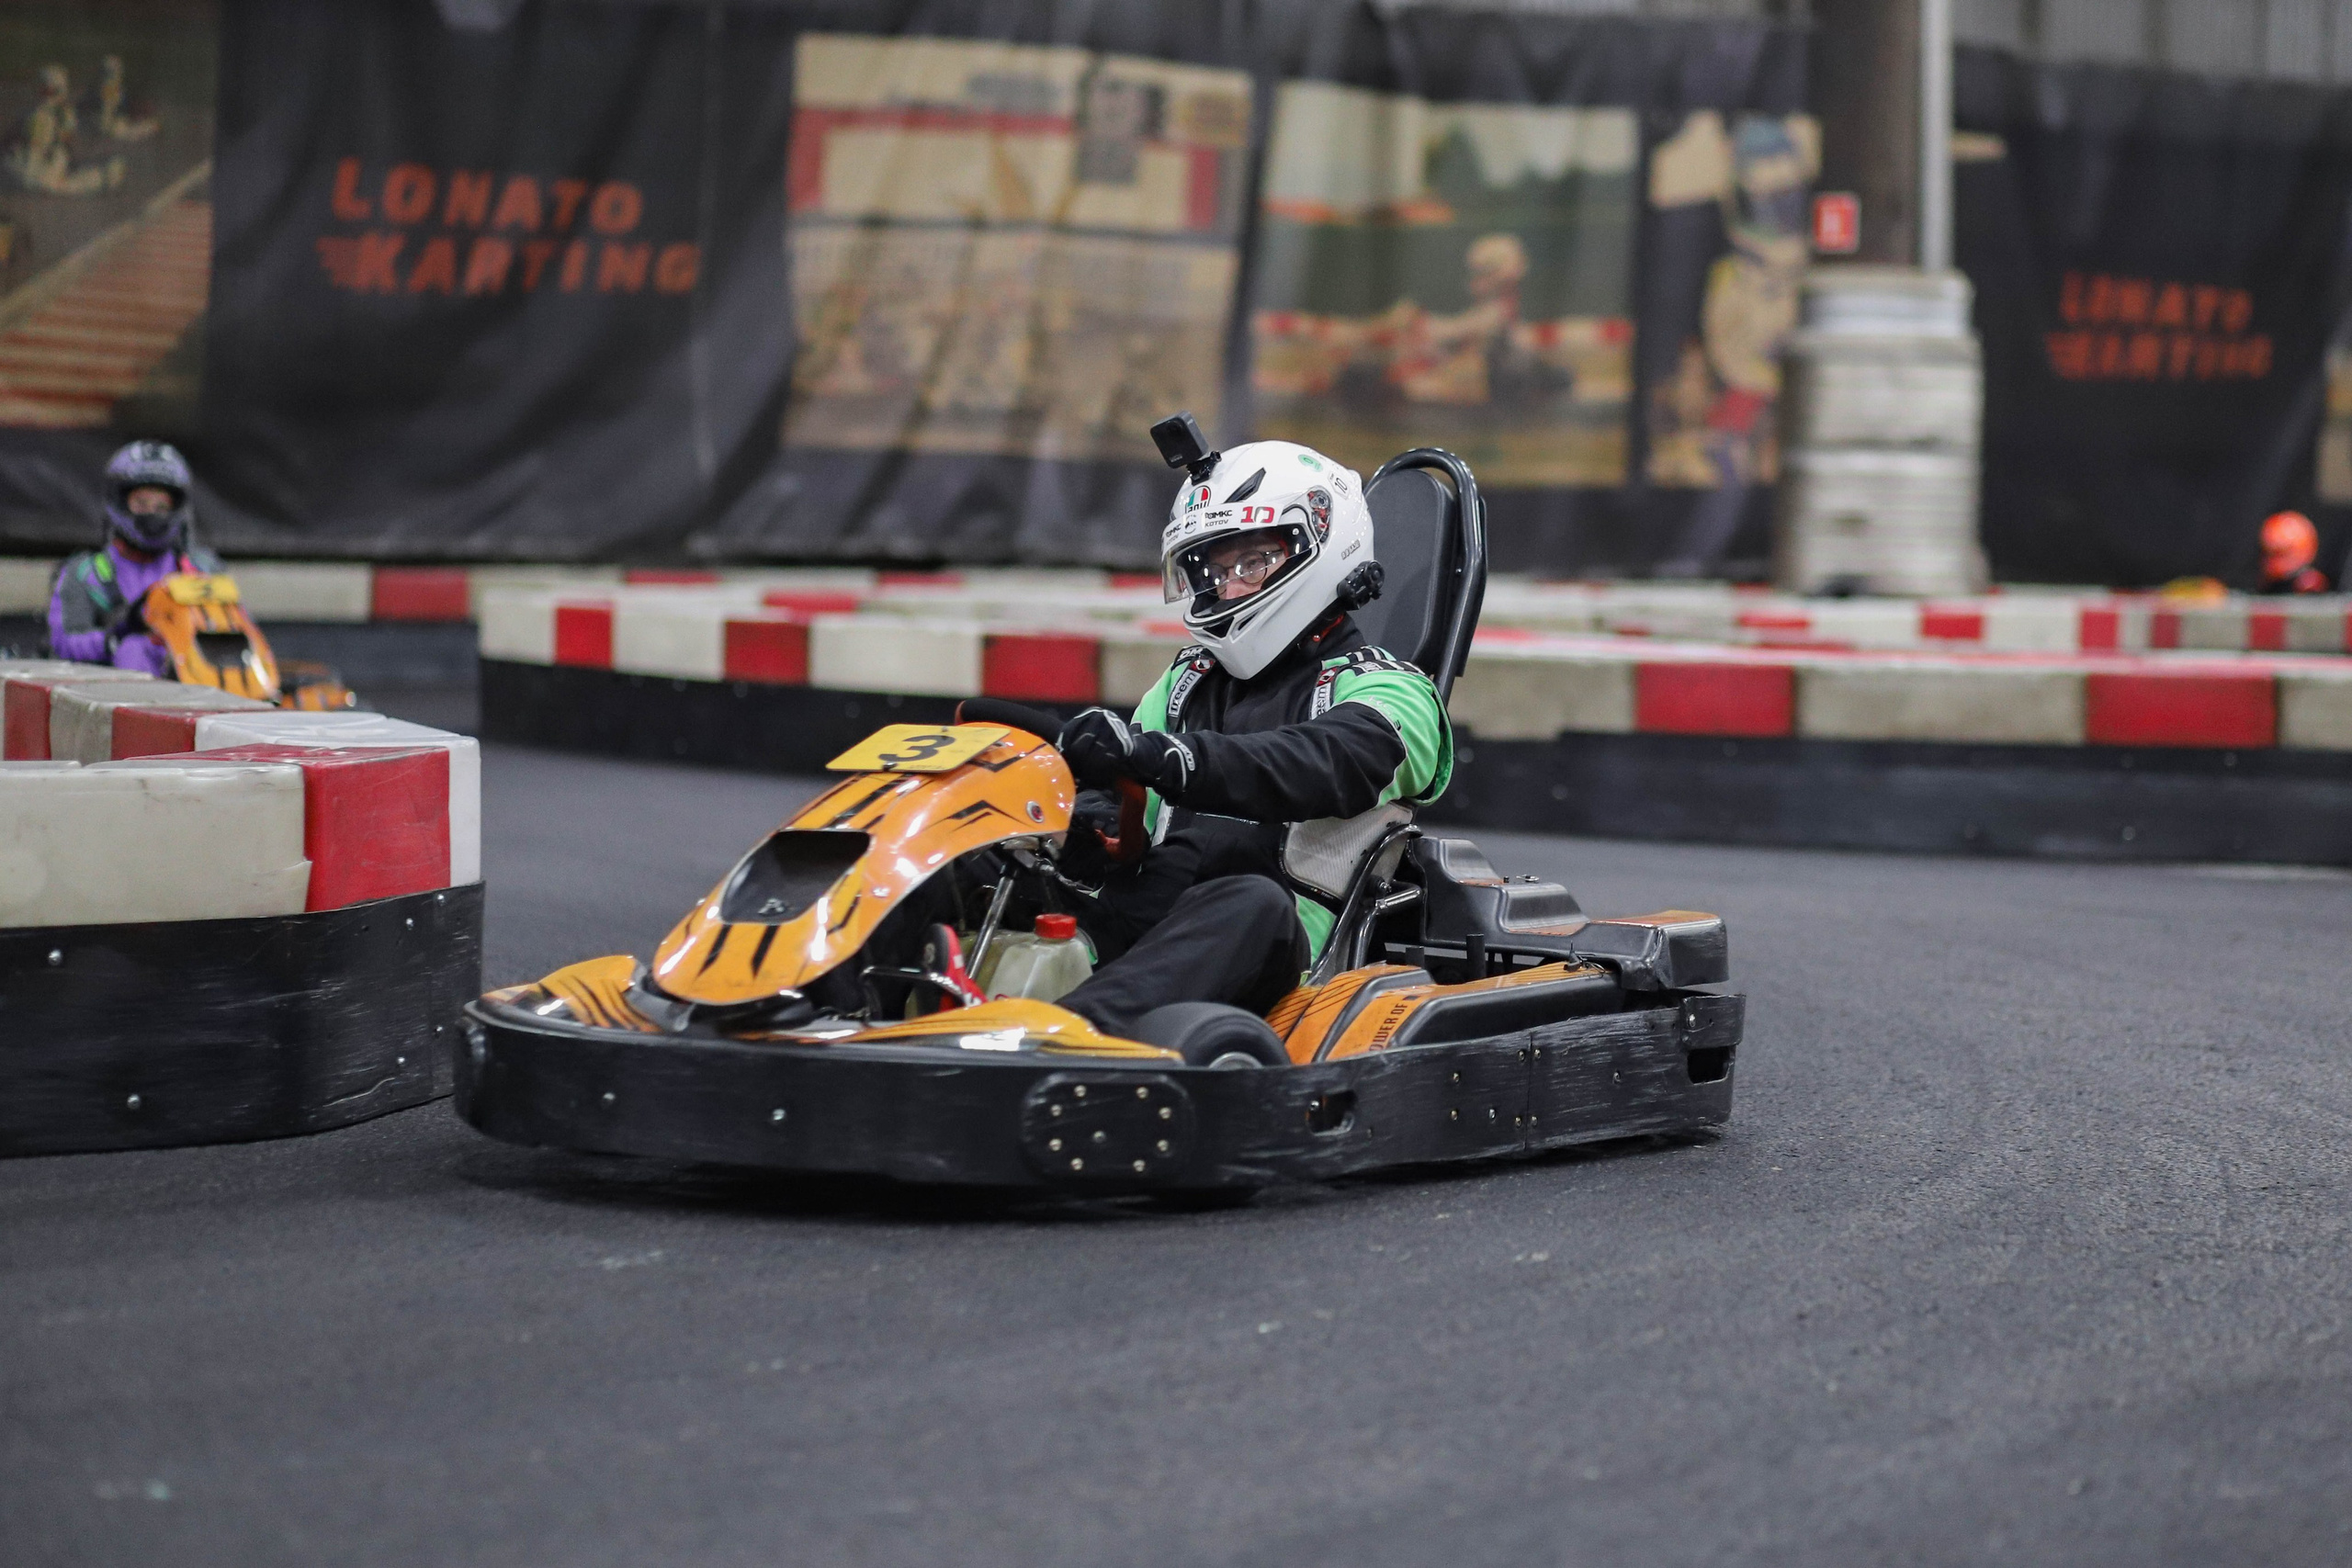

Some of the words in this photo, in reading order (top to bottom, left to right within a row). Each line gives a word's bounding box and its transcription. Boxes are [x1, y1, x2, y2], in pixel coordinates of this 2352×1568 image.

[331, 155, 642, 233] LONATO
[355, 231, 702, 296] KARTING
[878, 735, 956, 761] 3
[1369, 1017, 1399, 1051] OWER
